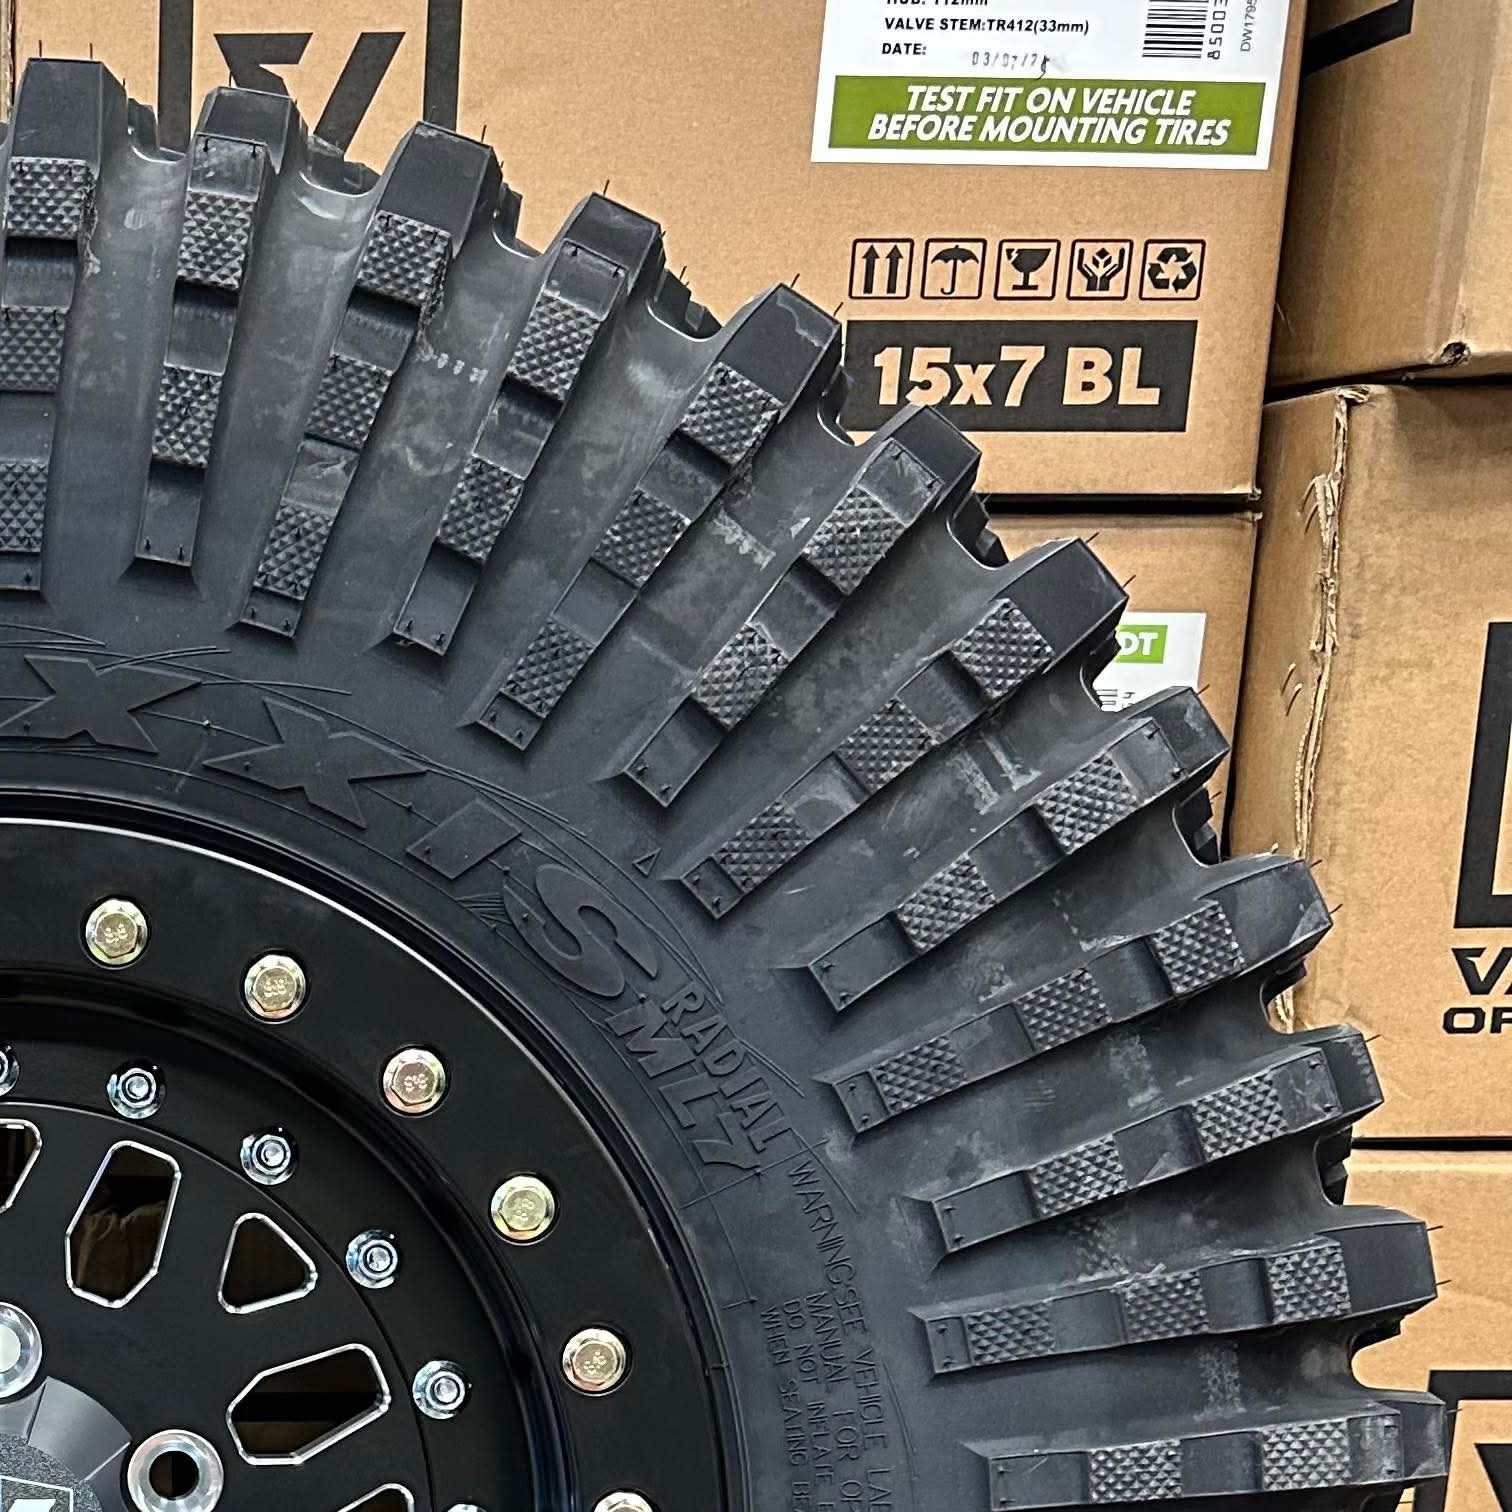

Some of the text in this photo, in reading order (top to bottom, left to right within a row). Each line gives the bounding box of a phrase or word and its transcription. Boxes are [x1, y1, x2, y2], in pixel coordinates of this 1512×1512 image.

[881, 42, 927, 56] DATE:
[884, 17, 936, 31] VALVE
[906, 85, 1197, 116] TEST FIT ON VEHICLE
[867, 114, 1231, 146] BEFORE MOUNTING TIRES
[873, 345, 1161, 407] 15x7 BL
[604, 1000, 763, 1172] ML7
[661, 982, 792, 1154] RADIAL
[760, 1305, 792, 1368] WHEN
[782, 1296, 808, 1329] DO
[793, 1343, 820, 1386] NOT
[804, 1290, 850, 1395] MANUAL
[852, 1347, 890, 1451] VEHICLE
